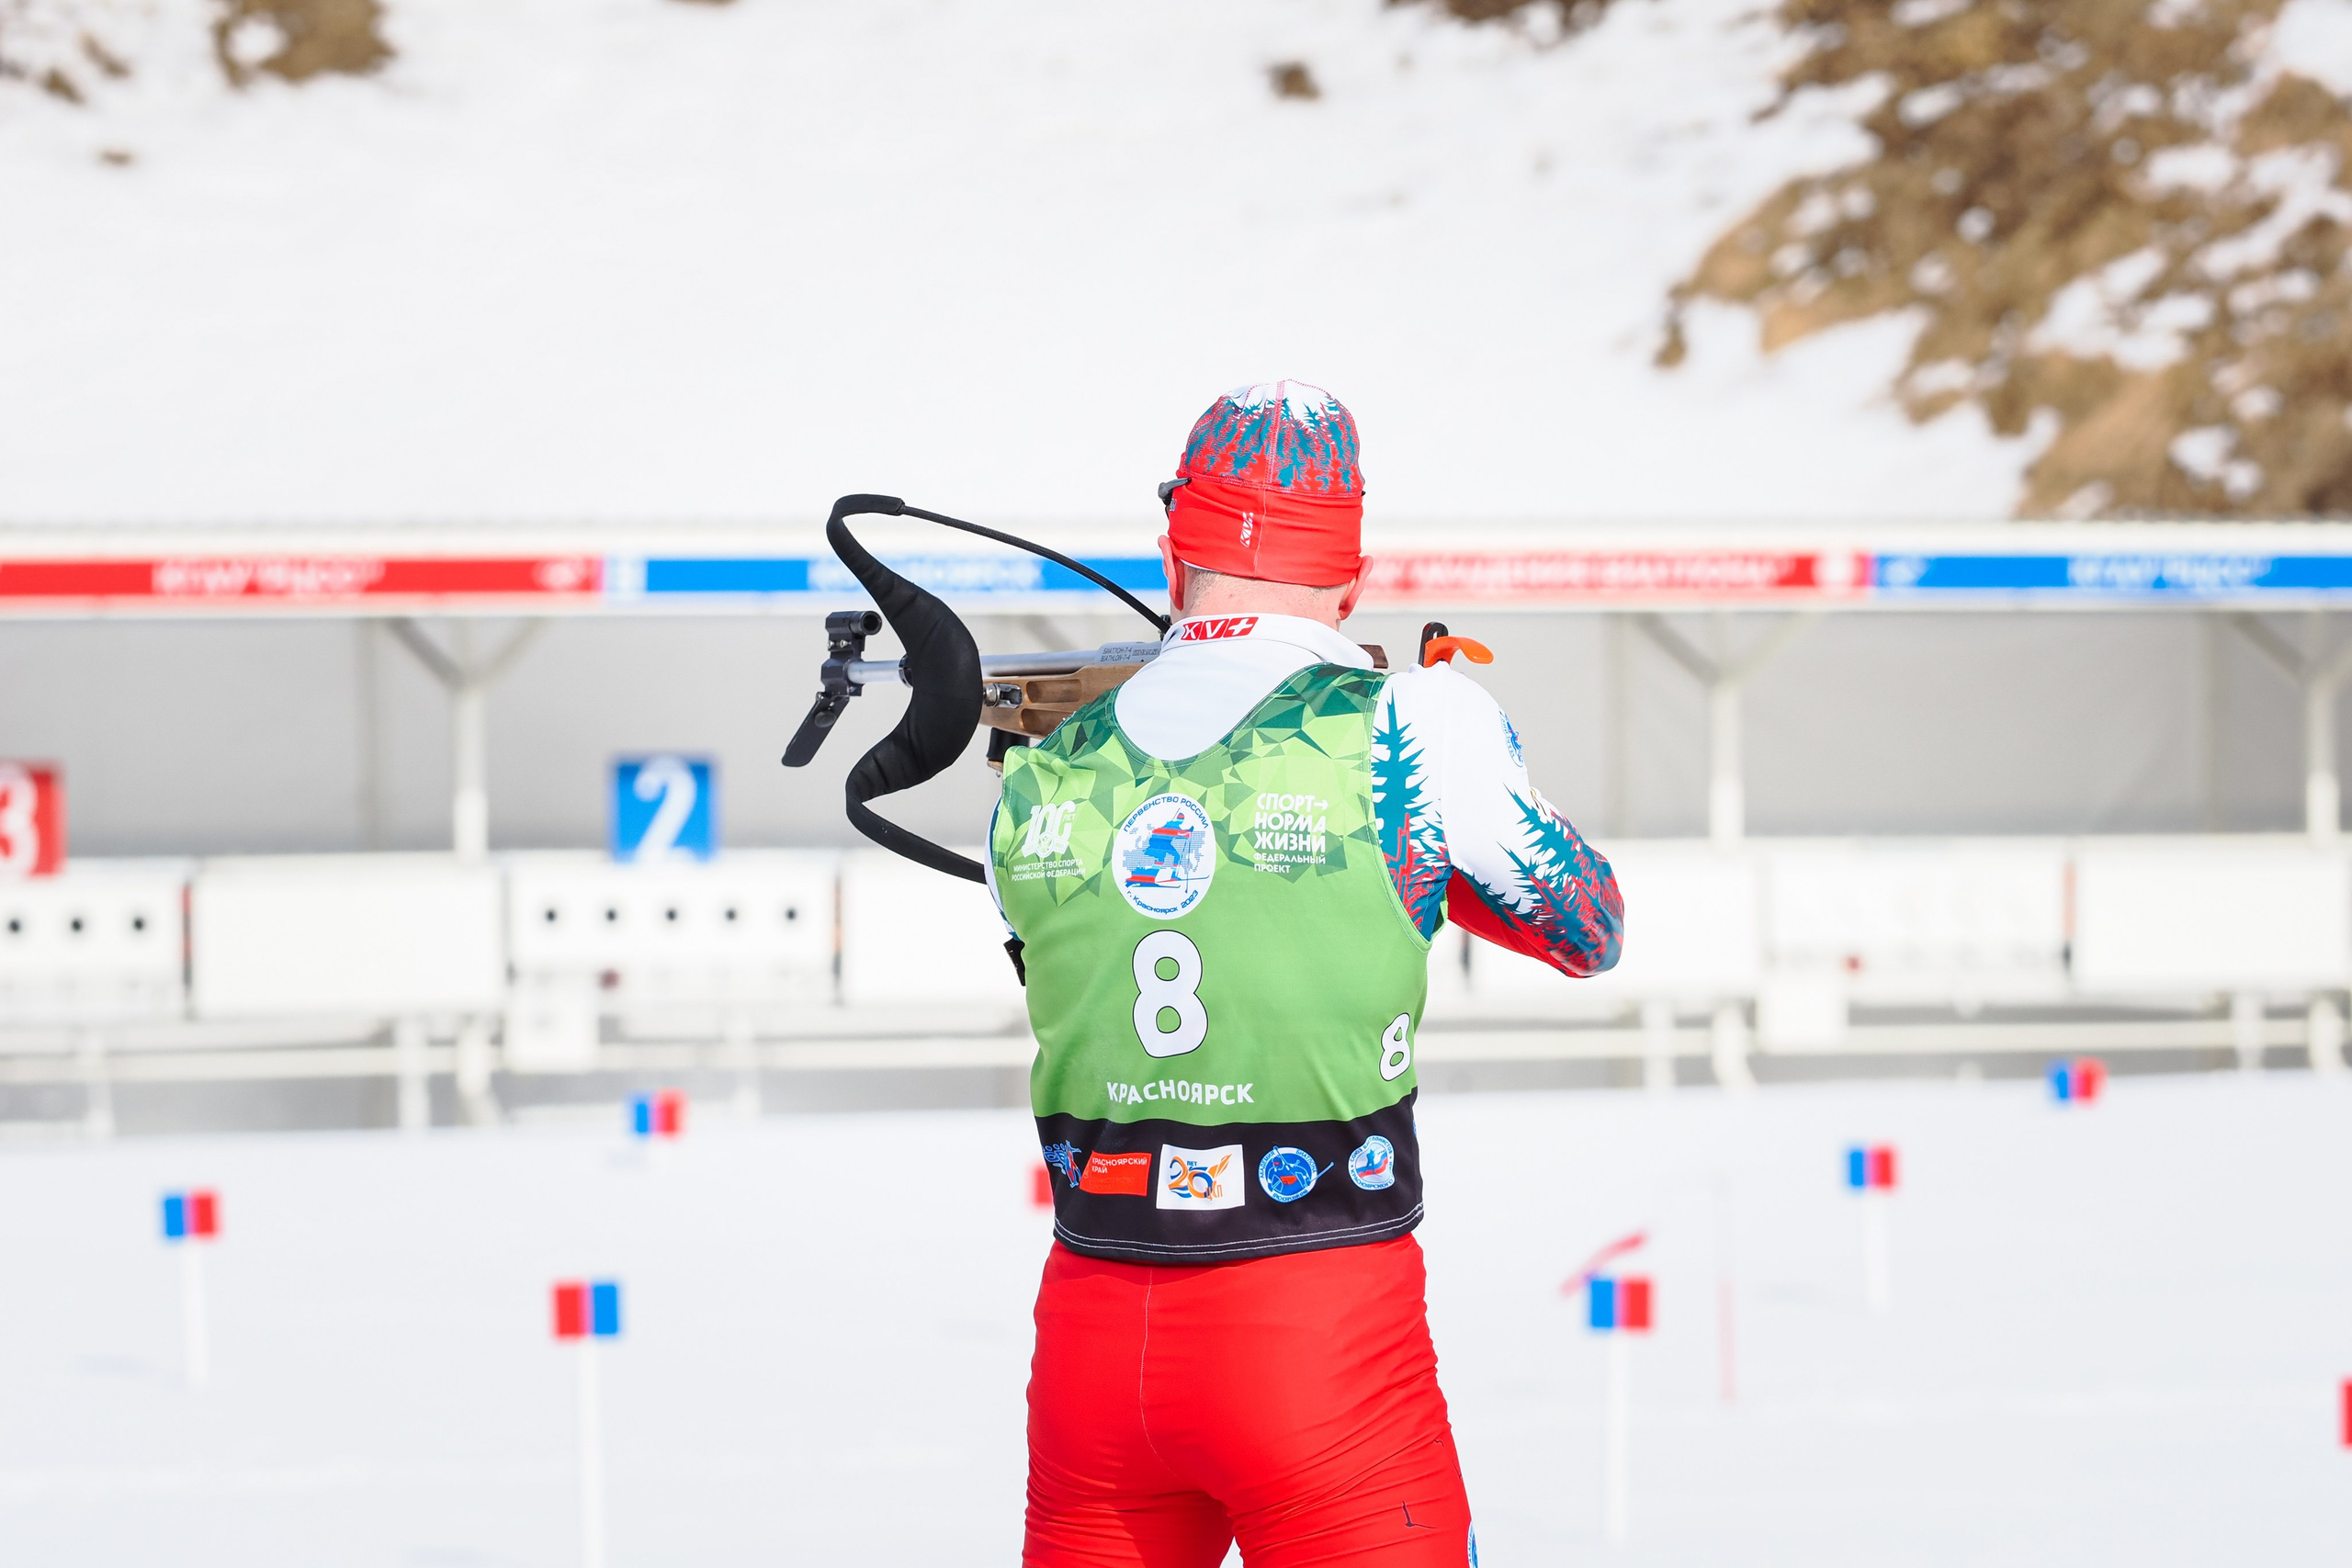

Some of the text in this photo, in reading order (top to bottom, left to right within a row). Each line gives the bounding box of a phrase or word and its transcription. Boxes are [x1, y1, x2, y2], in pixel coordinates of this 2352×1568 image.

[633, 757, 700, 863] 2
[1124, 795, 1209, 832] ПЕРВЕНСТВО РОССИИ
[1256, 793, 1316, 812] СПОРТ
[1254, 811, 1327, 833] НОРМА
[1254, 830, 1326, 853] ЖИЗНИ
[1013, 858, 1083, 873] МИНИСТЕРСТВО СПОРТА
[1253, 852, 1326, 864] ФЕДЕРАЛЬНЫЙ
[1254, 863, 1291, 874] ПРОЕКТ
[1012, 867, 1087, 882] РОССИЙСКОЙ ФЕДЕРАЦИИ
[1133, 895, 1179, 915] Красноярск
[1181, 889, 1199, 908] 2023
[1132, 930, 1208, 1058] 8
[1379, 1012, 1411, 1082] 8
[1106, 1079, 1255, 1105] КРАСНОЯРСК
[1350, 1136, 1392, 1162] СОЮЗ БИТЛОНИСТОВ
[1091, 1157, 1148, 1167] КРАСНОЯРСКИЙ
[1091, 1166, 1108, 1174] КРАЙ
[1260, 1149, 1317, 1179] АКАДЕМИЯ БИАТЛОНА
